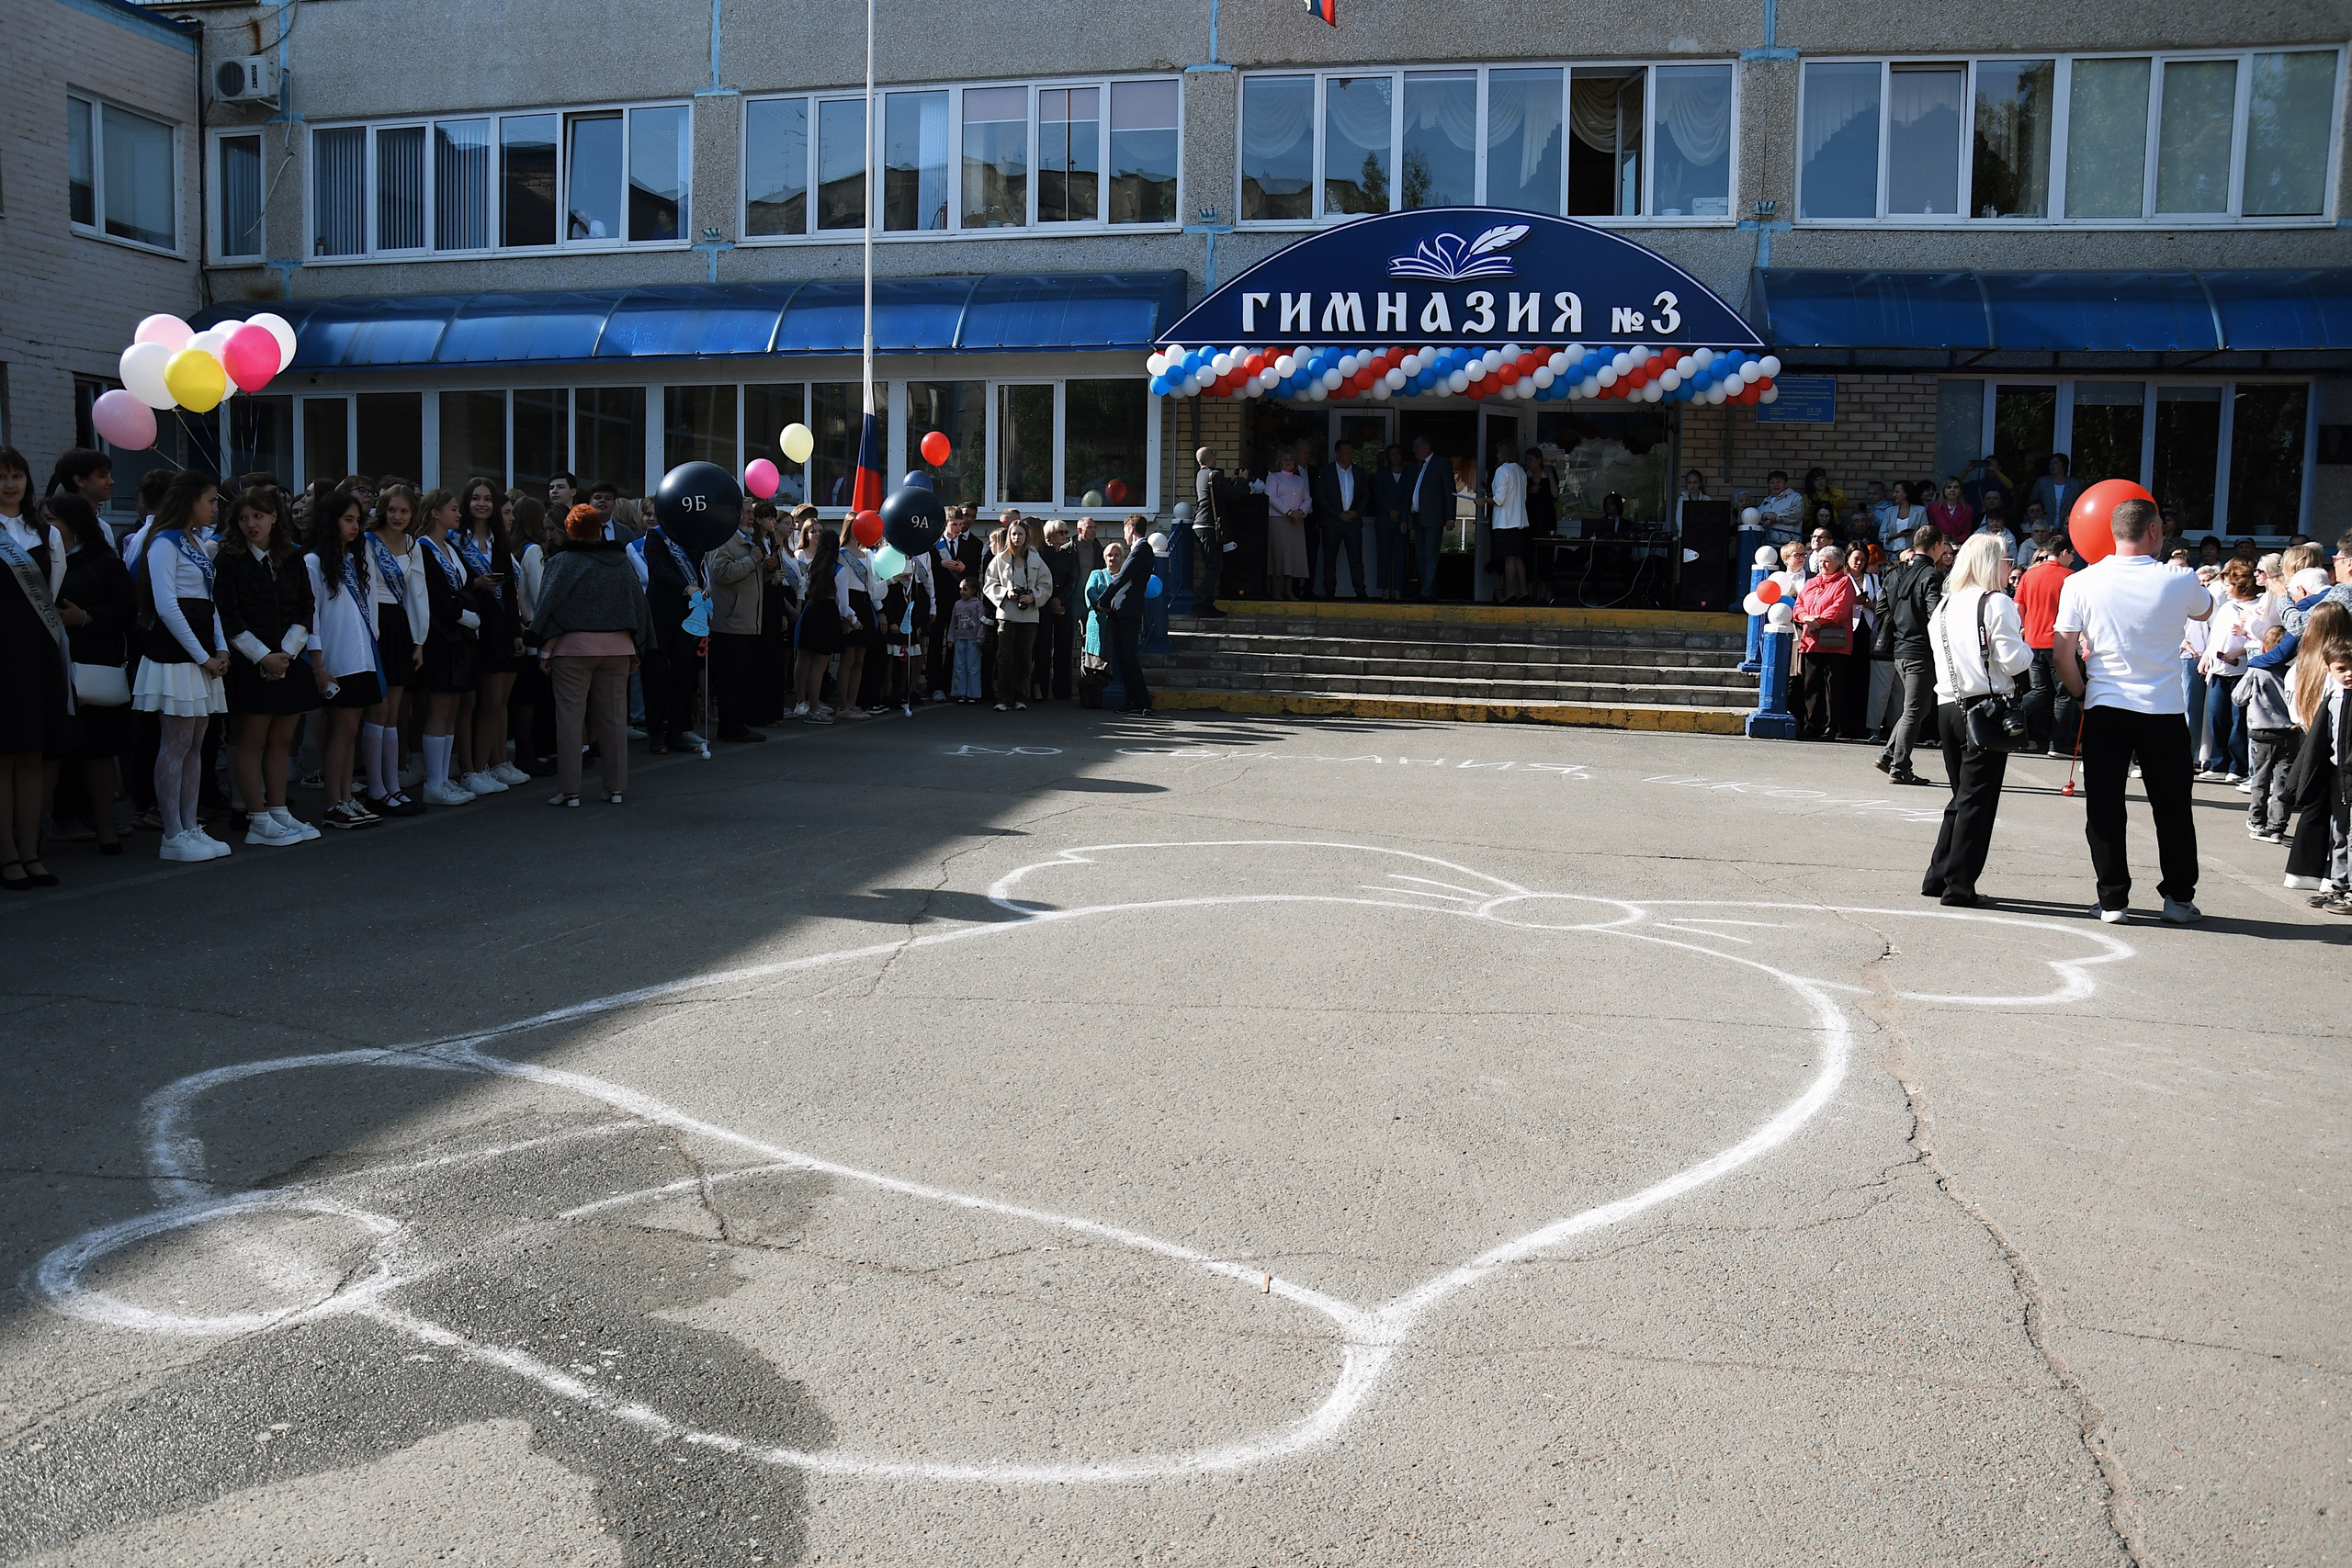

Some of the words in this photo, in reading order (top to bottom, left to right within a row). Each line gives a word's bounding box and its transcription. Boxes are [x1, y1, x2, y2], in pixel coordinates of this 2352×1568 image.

[1241, 291, 1583, 334] ГИМНАЗИЯ
[681, 495, 707, 513] 9Б
[910, 514, 930, 530] 9А
[38, 603, 59, 628] 2025
[944, 744, 1064, 757] ДО
